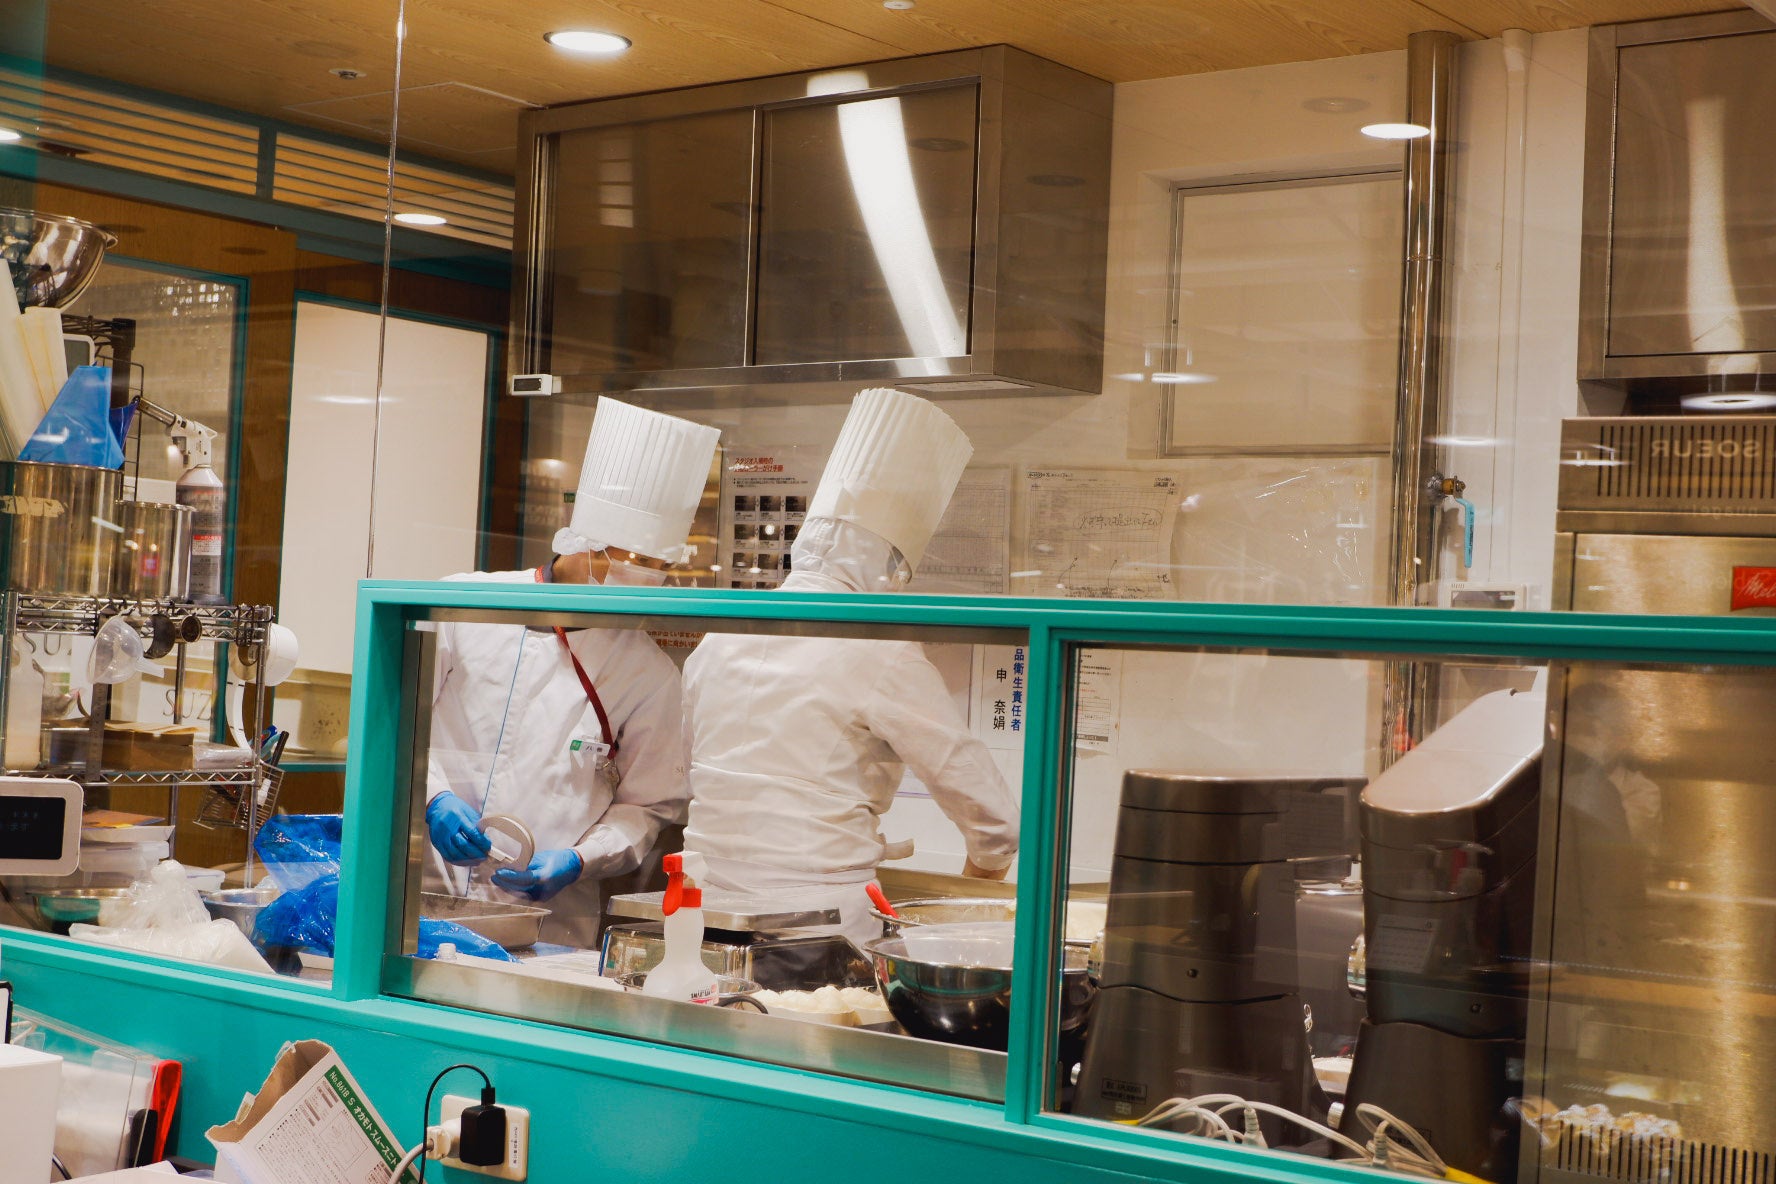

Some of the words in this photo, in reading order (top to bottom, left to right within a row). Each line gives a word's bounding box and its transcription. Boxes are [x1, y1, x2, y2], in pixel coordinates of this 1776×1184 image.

[1737, 572, 1776, 599] Mel
[996, 668, 1007, 682] 申
[1011, 648, 1024, 731] 品衛生責任者
[347, 1097, 356, 1106] S
[354, 1106, 373, 1131] オカモト
[370, 1130, 398, 1165] スムースニト
